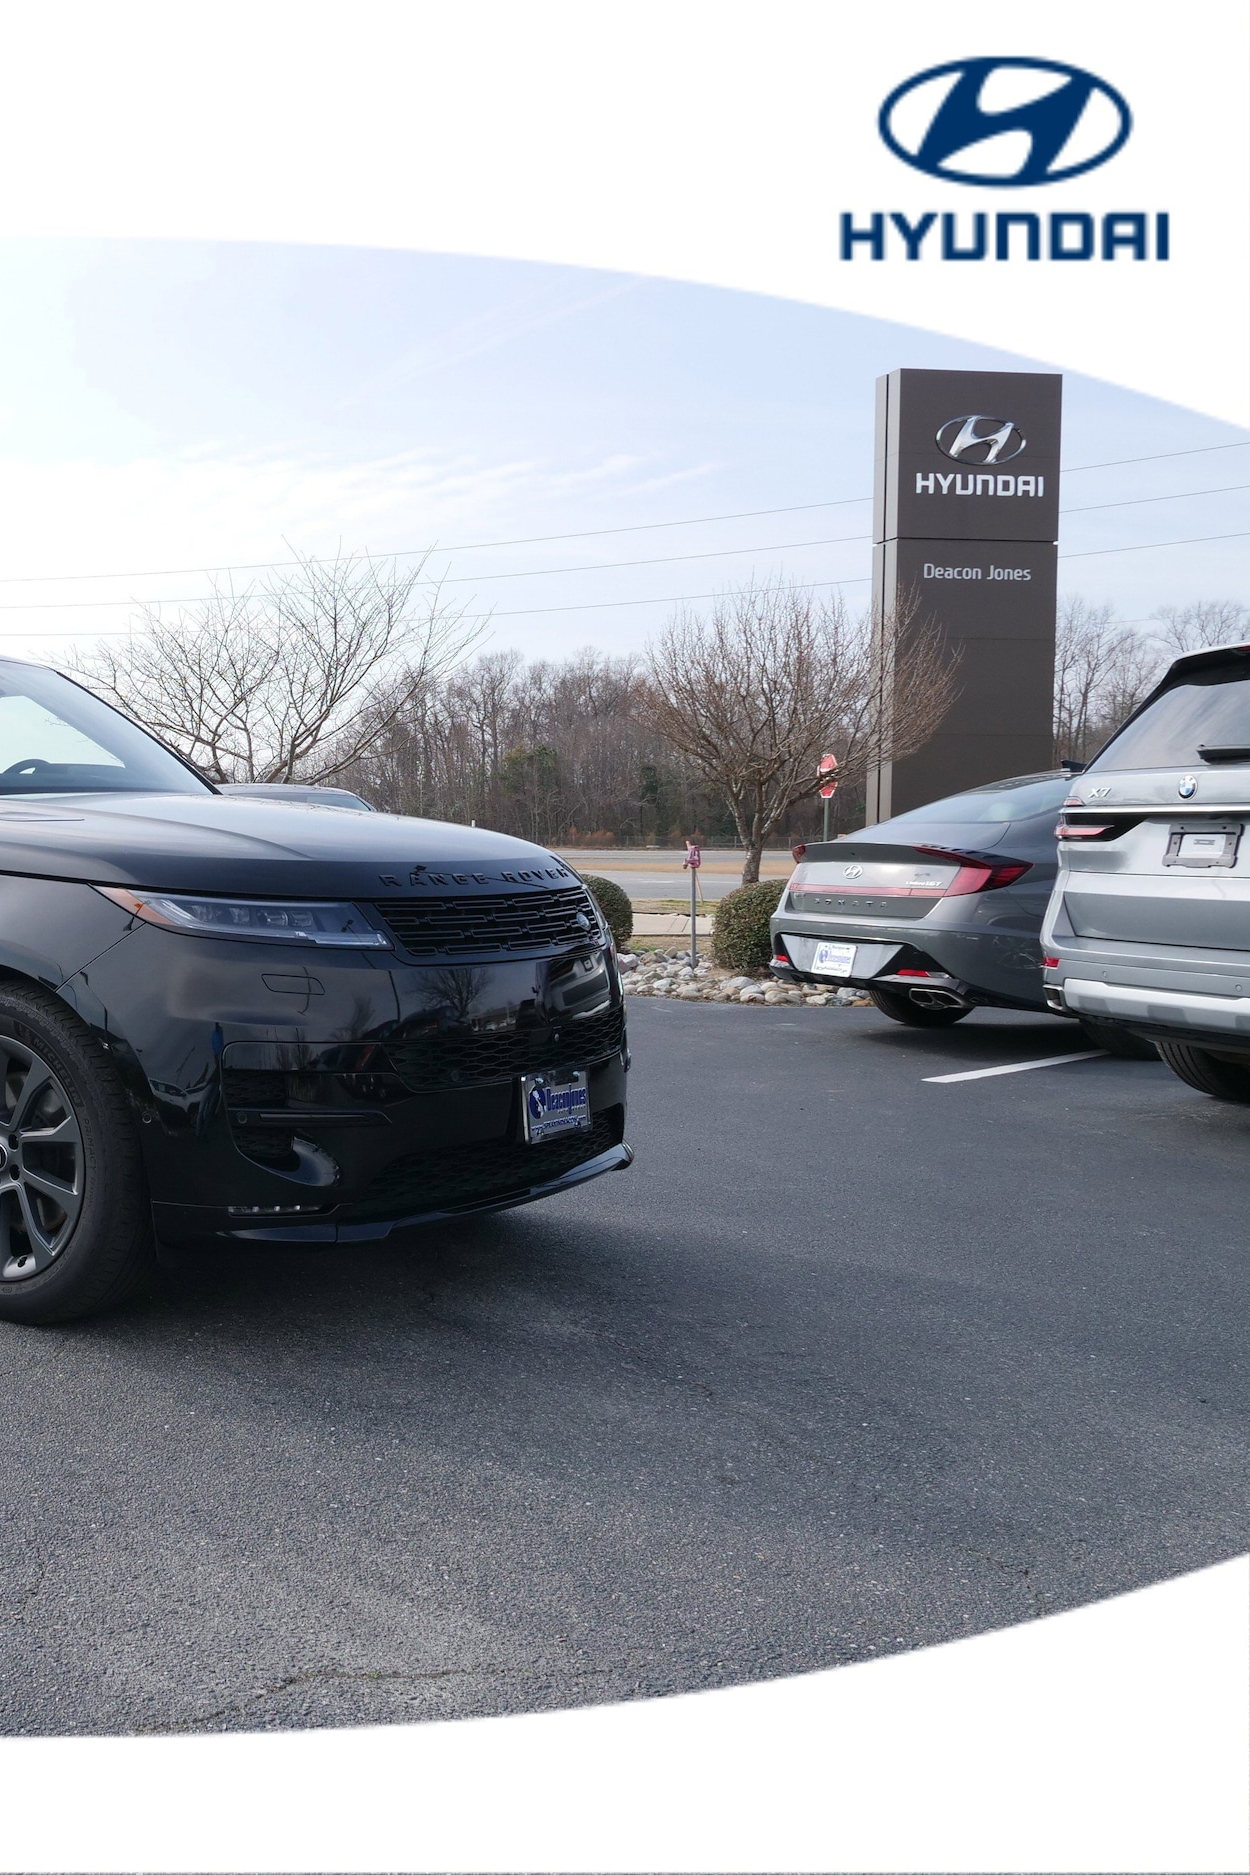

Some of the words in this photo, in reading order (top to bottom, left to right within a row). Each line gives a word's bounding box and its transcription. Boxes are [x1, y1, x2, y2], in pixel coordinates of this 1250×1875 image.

[915, 472, 1044, 497] HYUNDAI
[923, 563, 982, 580] Deacon
[986, 564, 1032, 581] Jones
[1088, 787, 1112, 798] X7
[378, 872, 490, 887] RANGE
[500, 867, 570, 883] ROVER
[33, 1036, 82, 1104] MICHELIN
